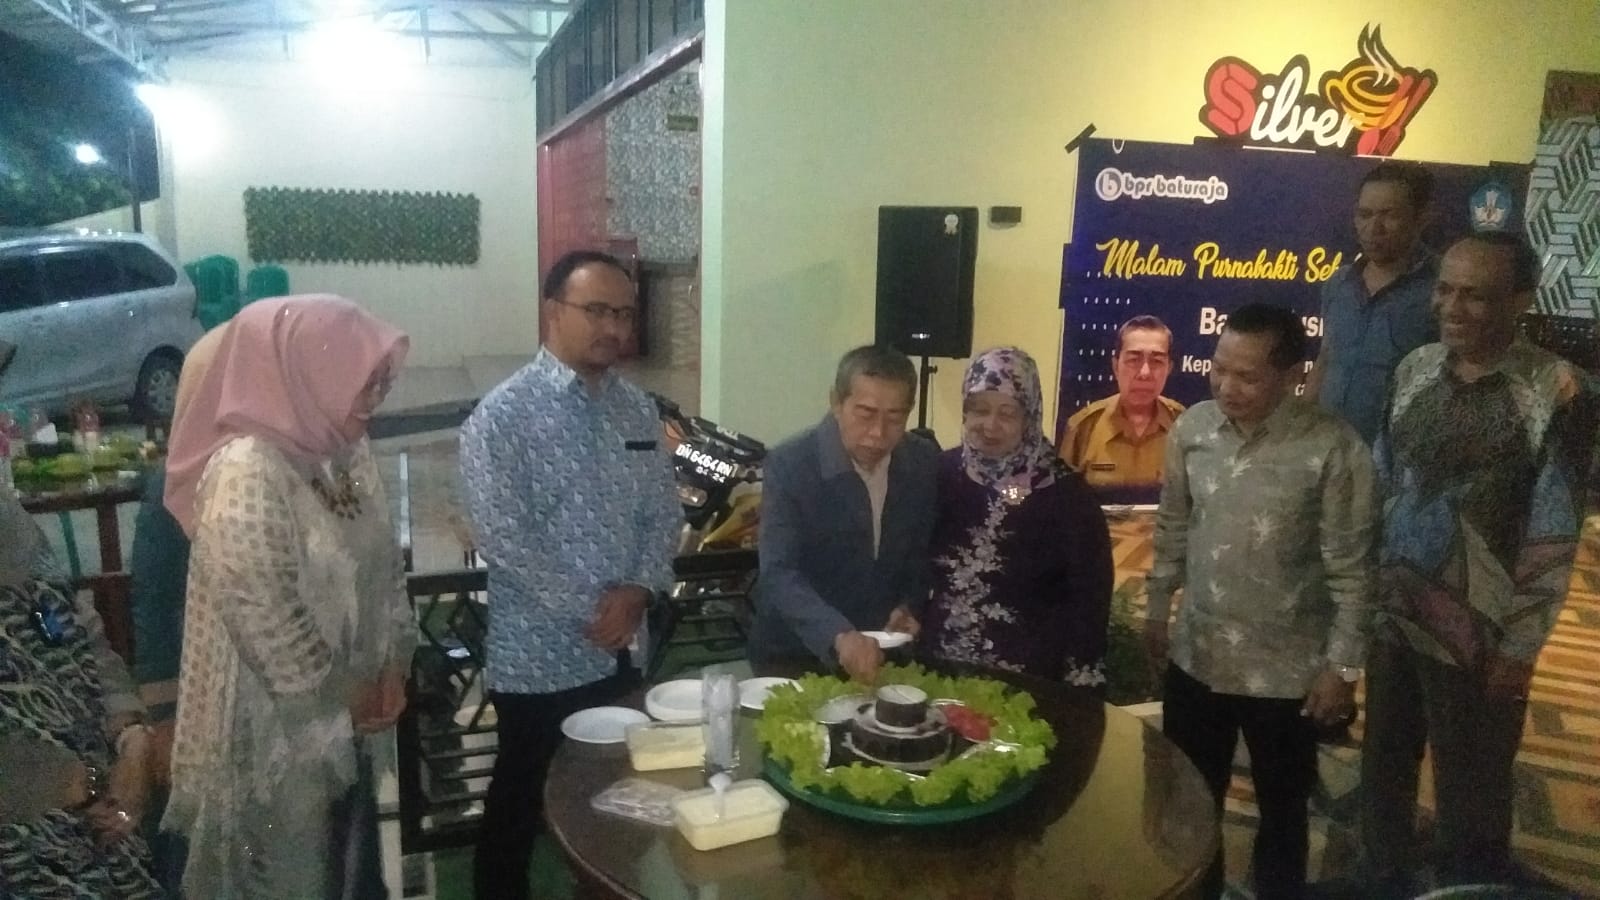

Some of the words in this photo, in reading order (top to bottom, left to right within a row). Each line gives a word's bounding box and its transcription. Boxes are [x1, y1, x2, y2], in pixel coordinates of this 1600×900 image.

[1207, 63, 1364, 149] Silver
[1096, 238, 1187, 280] Malam
[1193, 241, 1299, 281] Purnabakti
[690, 450, 719, 471] 6464
